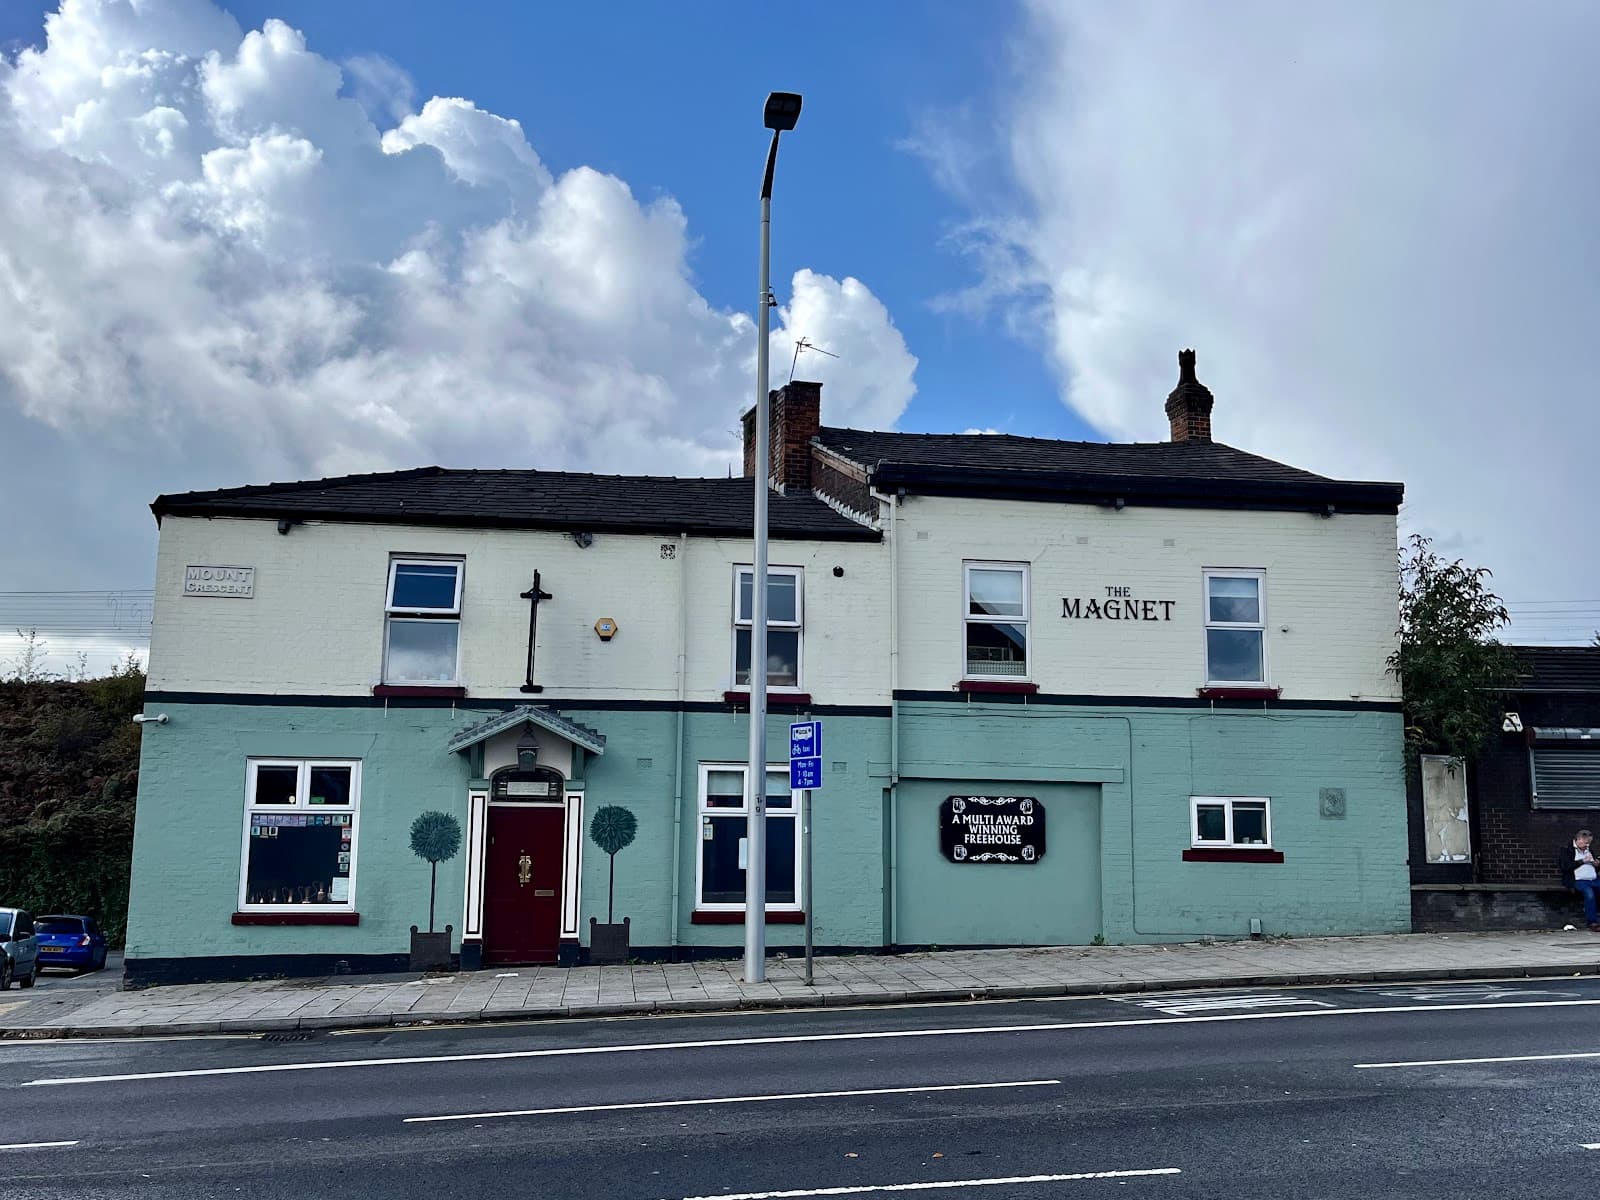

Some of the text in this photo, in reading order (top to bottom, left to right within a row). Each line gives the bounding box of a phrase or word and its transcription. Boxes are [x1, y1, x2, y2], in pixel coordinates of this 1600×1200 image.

[187, 569, 251, 582] MOUNT
[187, 581, 252, 595] CRESCENT
[1104, 586, 1131, 598] THE
[1061, 598, 1176, 621] MAGNET
[952, 814, 1034, 825] A MULTI AWARD
[969, 824, 1018, 835] WINNING
[964, 834, 1022, 845] FREEHOUSE
